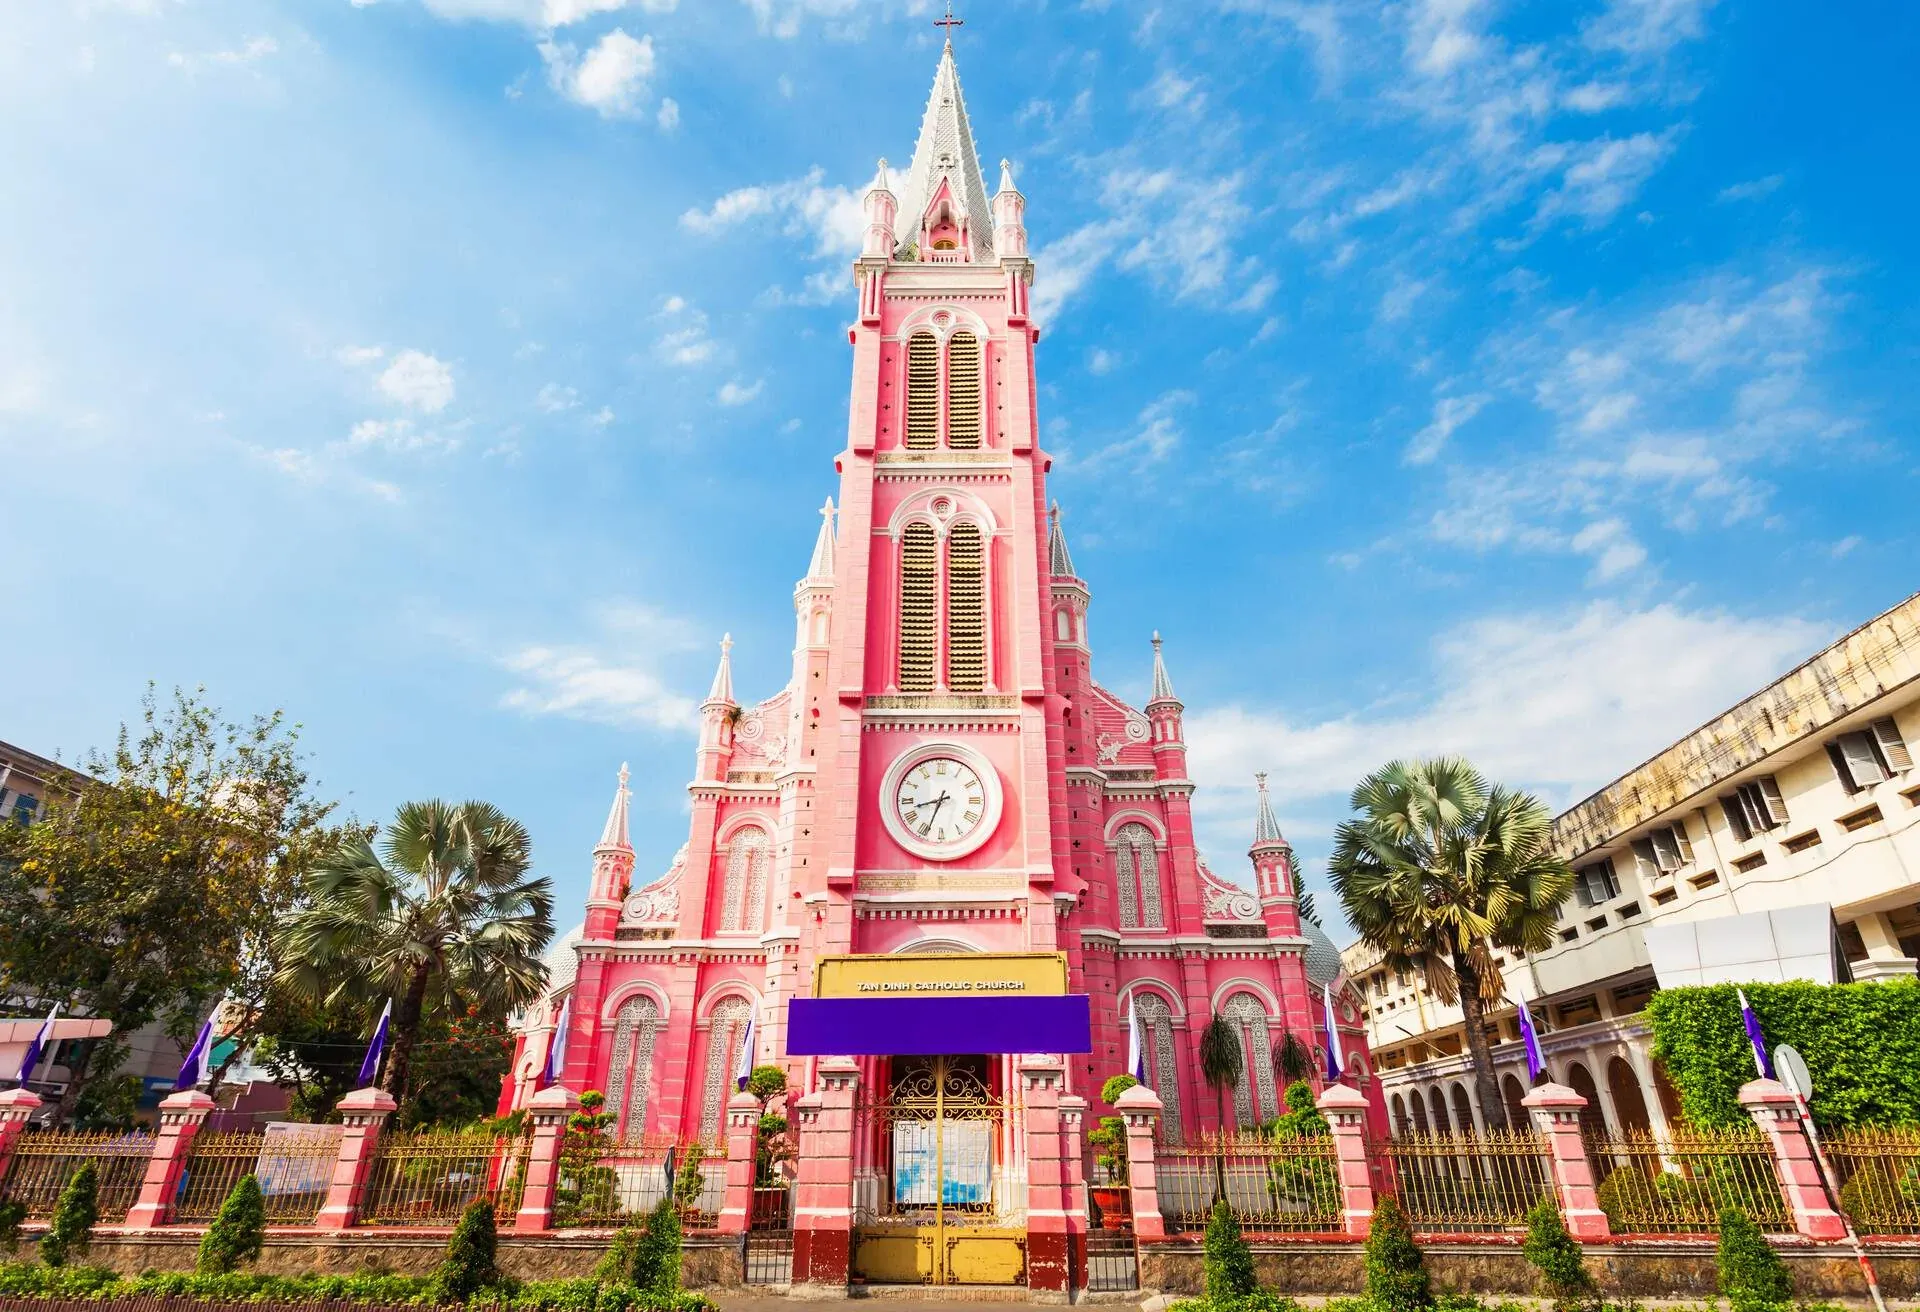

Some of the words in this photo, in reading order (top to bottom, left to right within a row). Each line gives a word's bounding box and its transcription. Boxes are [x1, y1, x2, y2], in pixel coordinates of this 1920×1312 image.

[857, 982, 880, 991] TAN
[883, 982, 911, 991] DINH
[914, 981, 972, 990] CATHOLIC
[975, 980, 1025, 990] CHURCH
